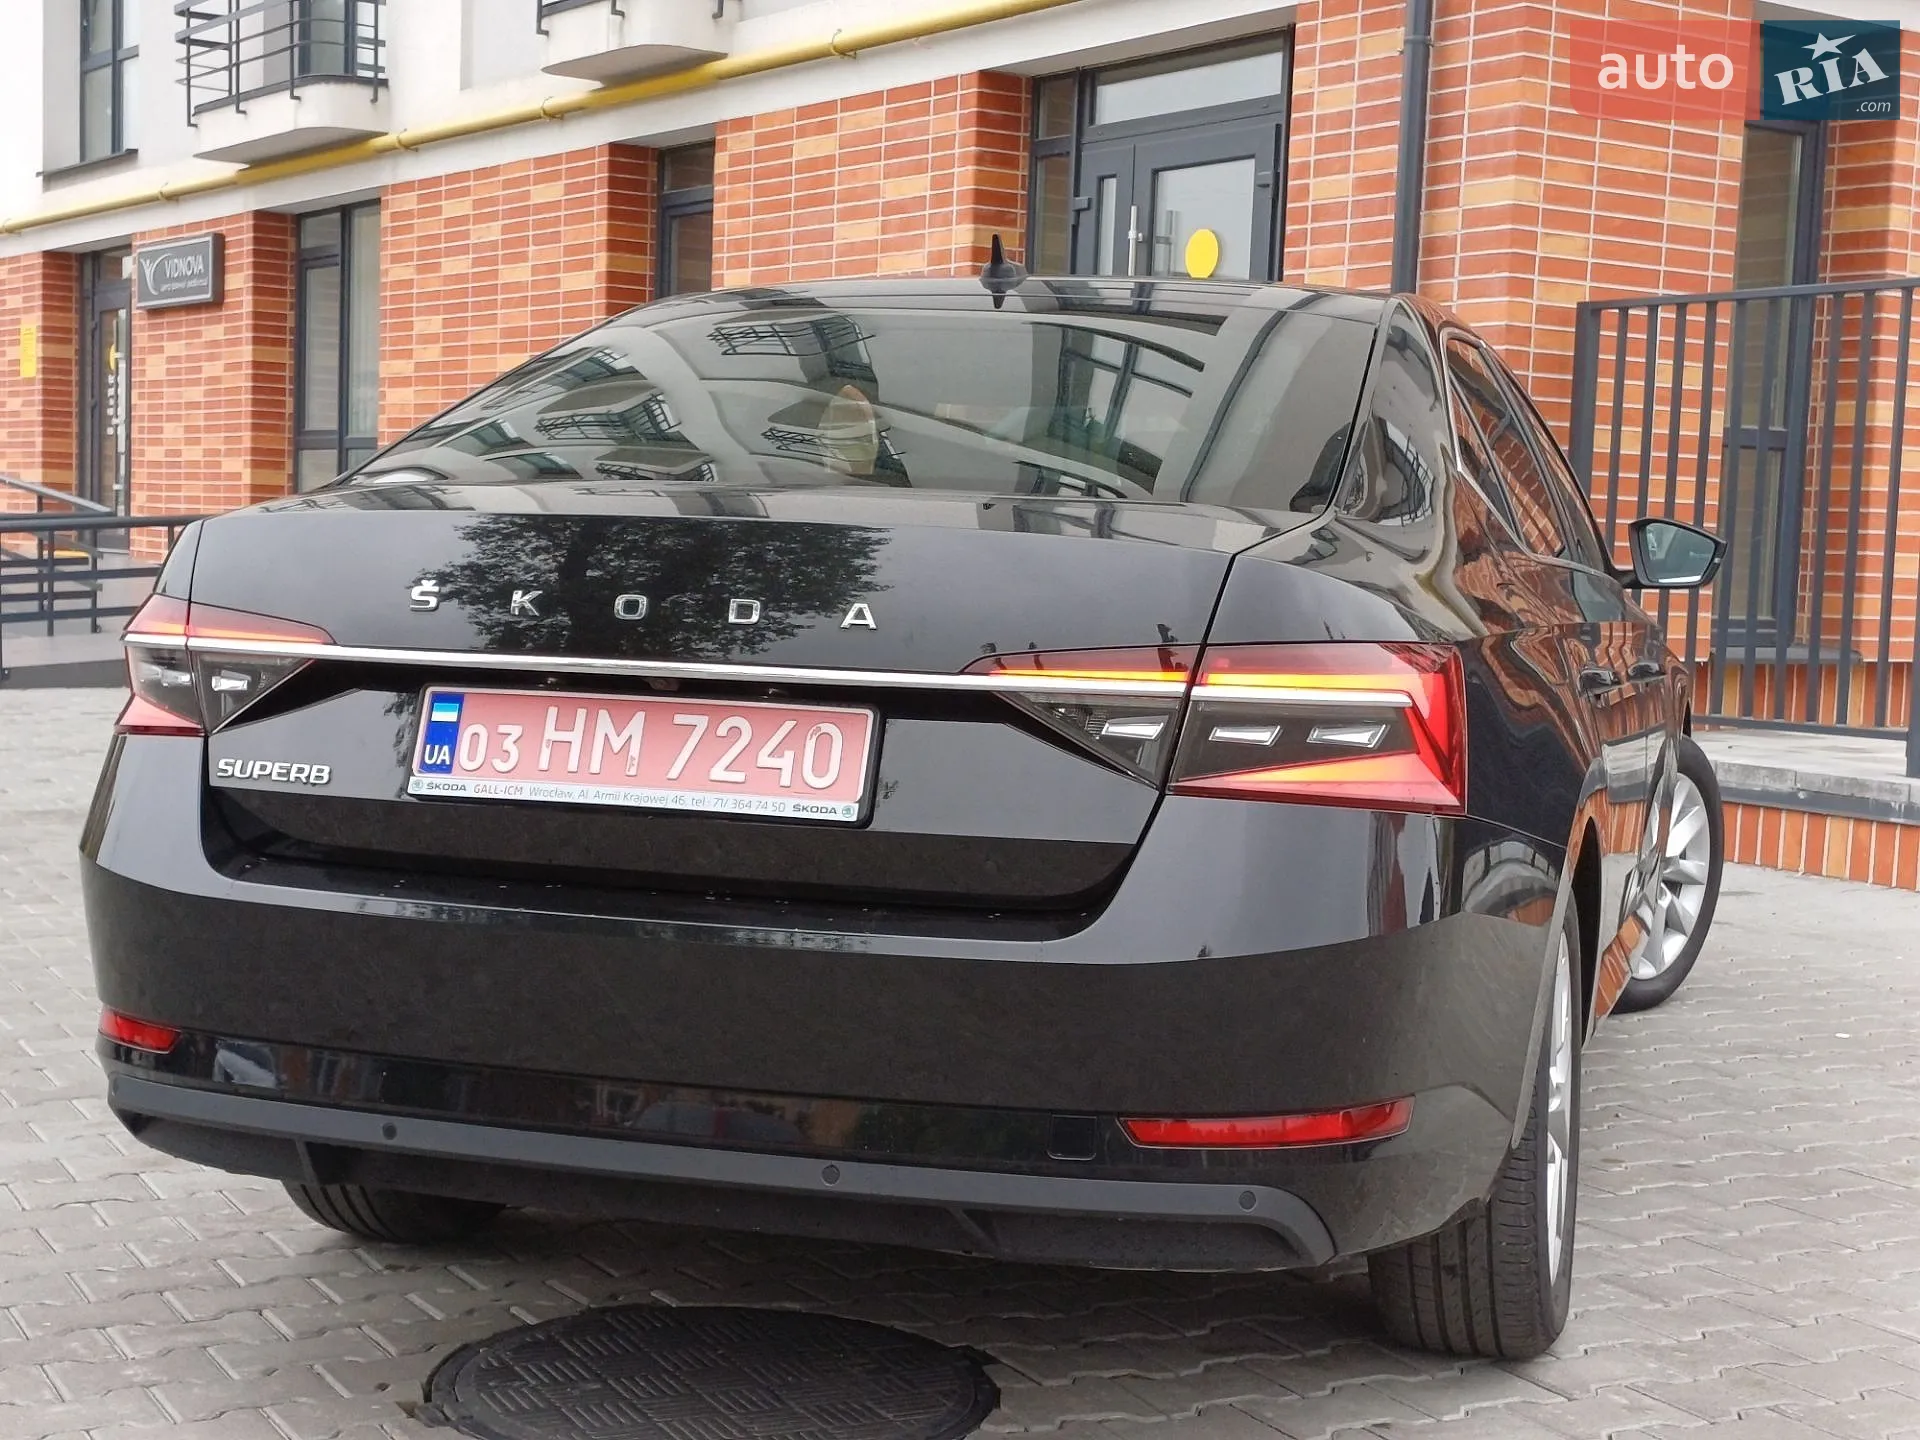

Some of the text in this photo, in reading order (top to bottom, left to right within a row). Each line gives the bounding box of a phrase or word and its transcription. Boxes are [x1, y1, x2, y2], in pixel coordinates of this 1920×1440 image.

[164, 254, 204, 278] VIDNOVA
[424, 744, 451, 765] UA
[459, 706, 844, 790] 03 HM 7240
[216, 758, 332, 786] SUPERB
[473, 784, 523, 795] GALL-ICM
[594, 790, 620, 801] Armii
[623, 791, 669, 807] Krajowej
[732, 798, 752, 810] 364
[755, 800, 769, 811] 74
[772, 801, 786, 813] 50
